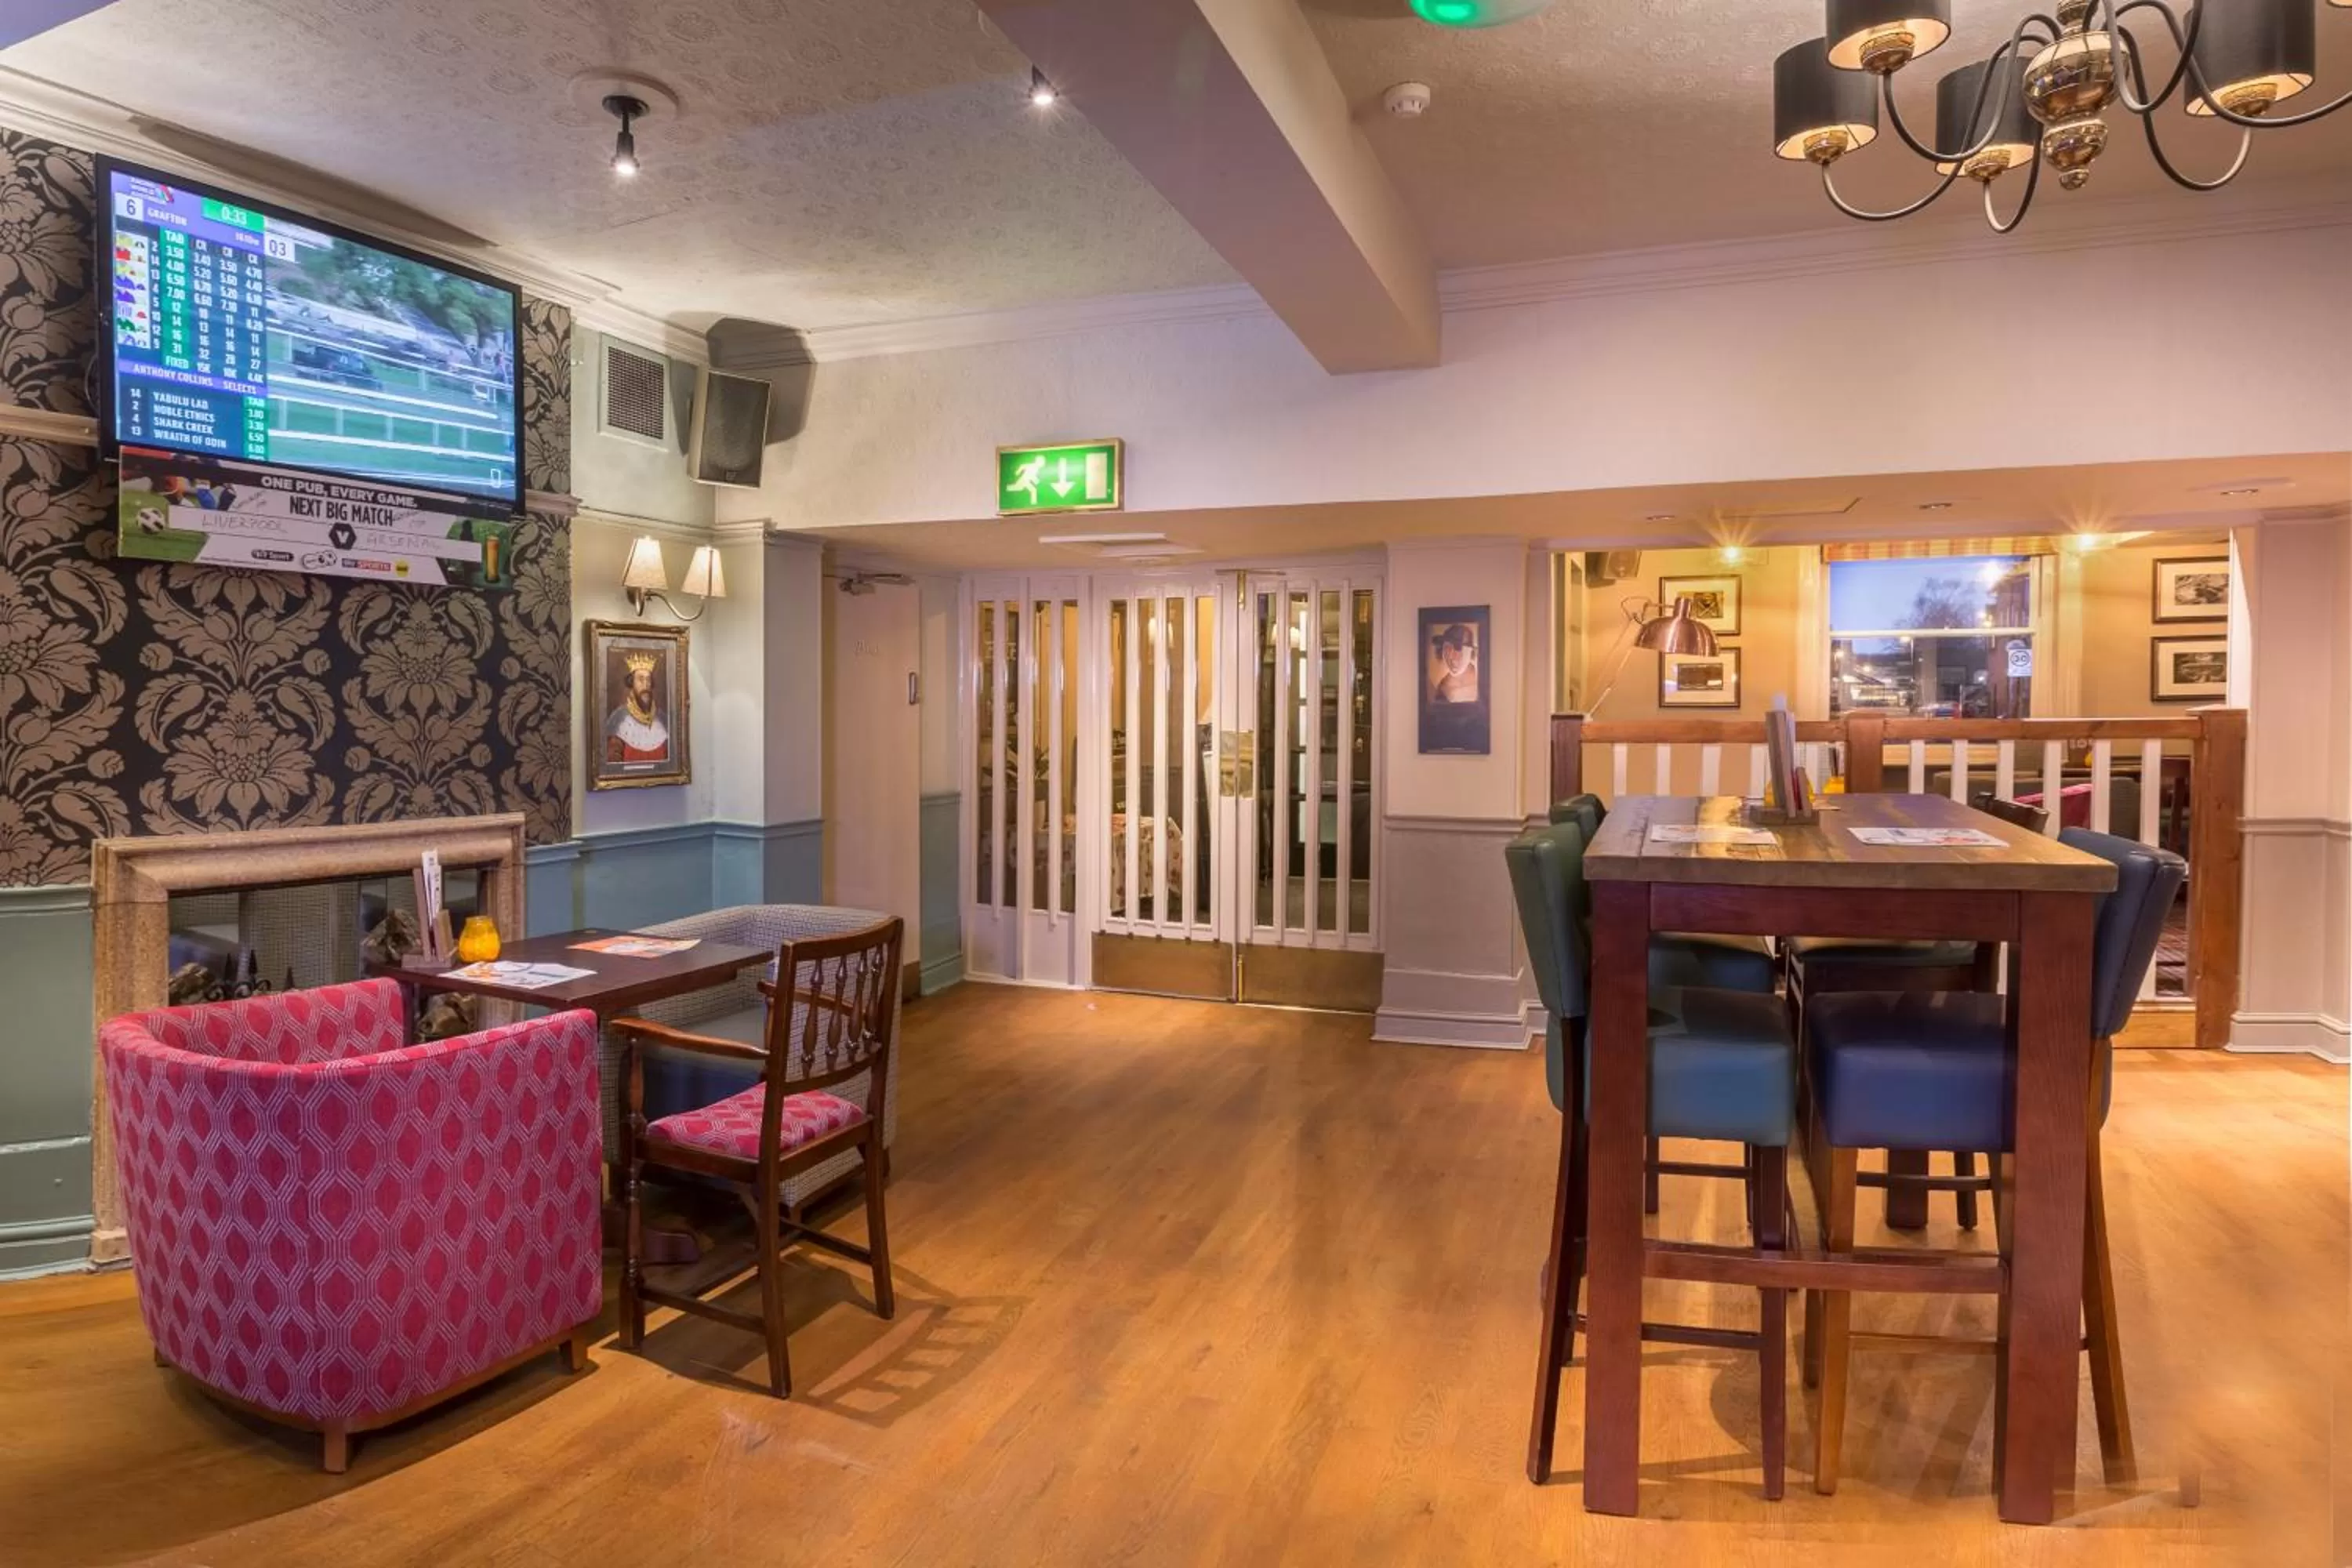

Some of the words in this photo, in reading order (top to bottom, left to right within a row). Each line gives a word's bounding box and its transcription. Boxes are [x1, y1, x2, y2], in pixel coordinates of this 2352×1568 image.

[126, 199, 136, 215] 6
[151, 241, 158, 252] 2
[164, 230, 184, 245] TAB
[152, 297, 160, 308] 5
[250, 359, 261, 370] 27
[133, 364, 176, 379] ANTHONY
[178, 372, 213, 386] COLLINS
[152, 391, 190, 407] YABULU
[191, 398, 209, 410] LAD
[132, 401, 139, 410] 2
[153, 405, 183, 418] NOBLE
[184, 410, 216, 423] ETHICS
[154, 416, 184, 430] SHARK
[186, 422, 214, 434] CREEK
[153, 429, 190, 443] WRAITH
[192, 435, 203, 445] OF
[205, 437, 227, 448] ODIN
[261, 476, 293, 492] ONE
[296, 481, 328, 498] PUB,
[330, 484, 375, 503] EVERY
[376, 493, 418, 509] GAME.
[289, 495, 323, 518] NEXT
[325, 500, 348, 522] BIG
[351, 505, 394, 528] MATCH
[201, 513, 289, 535] LIVERPOOL
[336, 530, 350, 545] V
